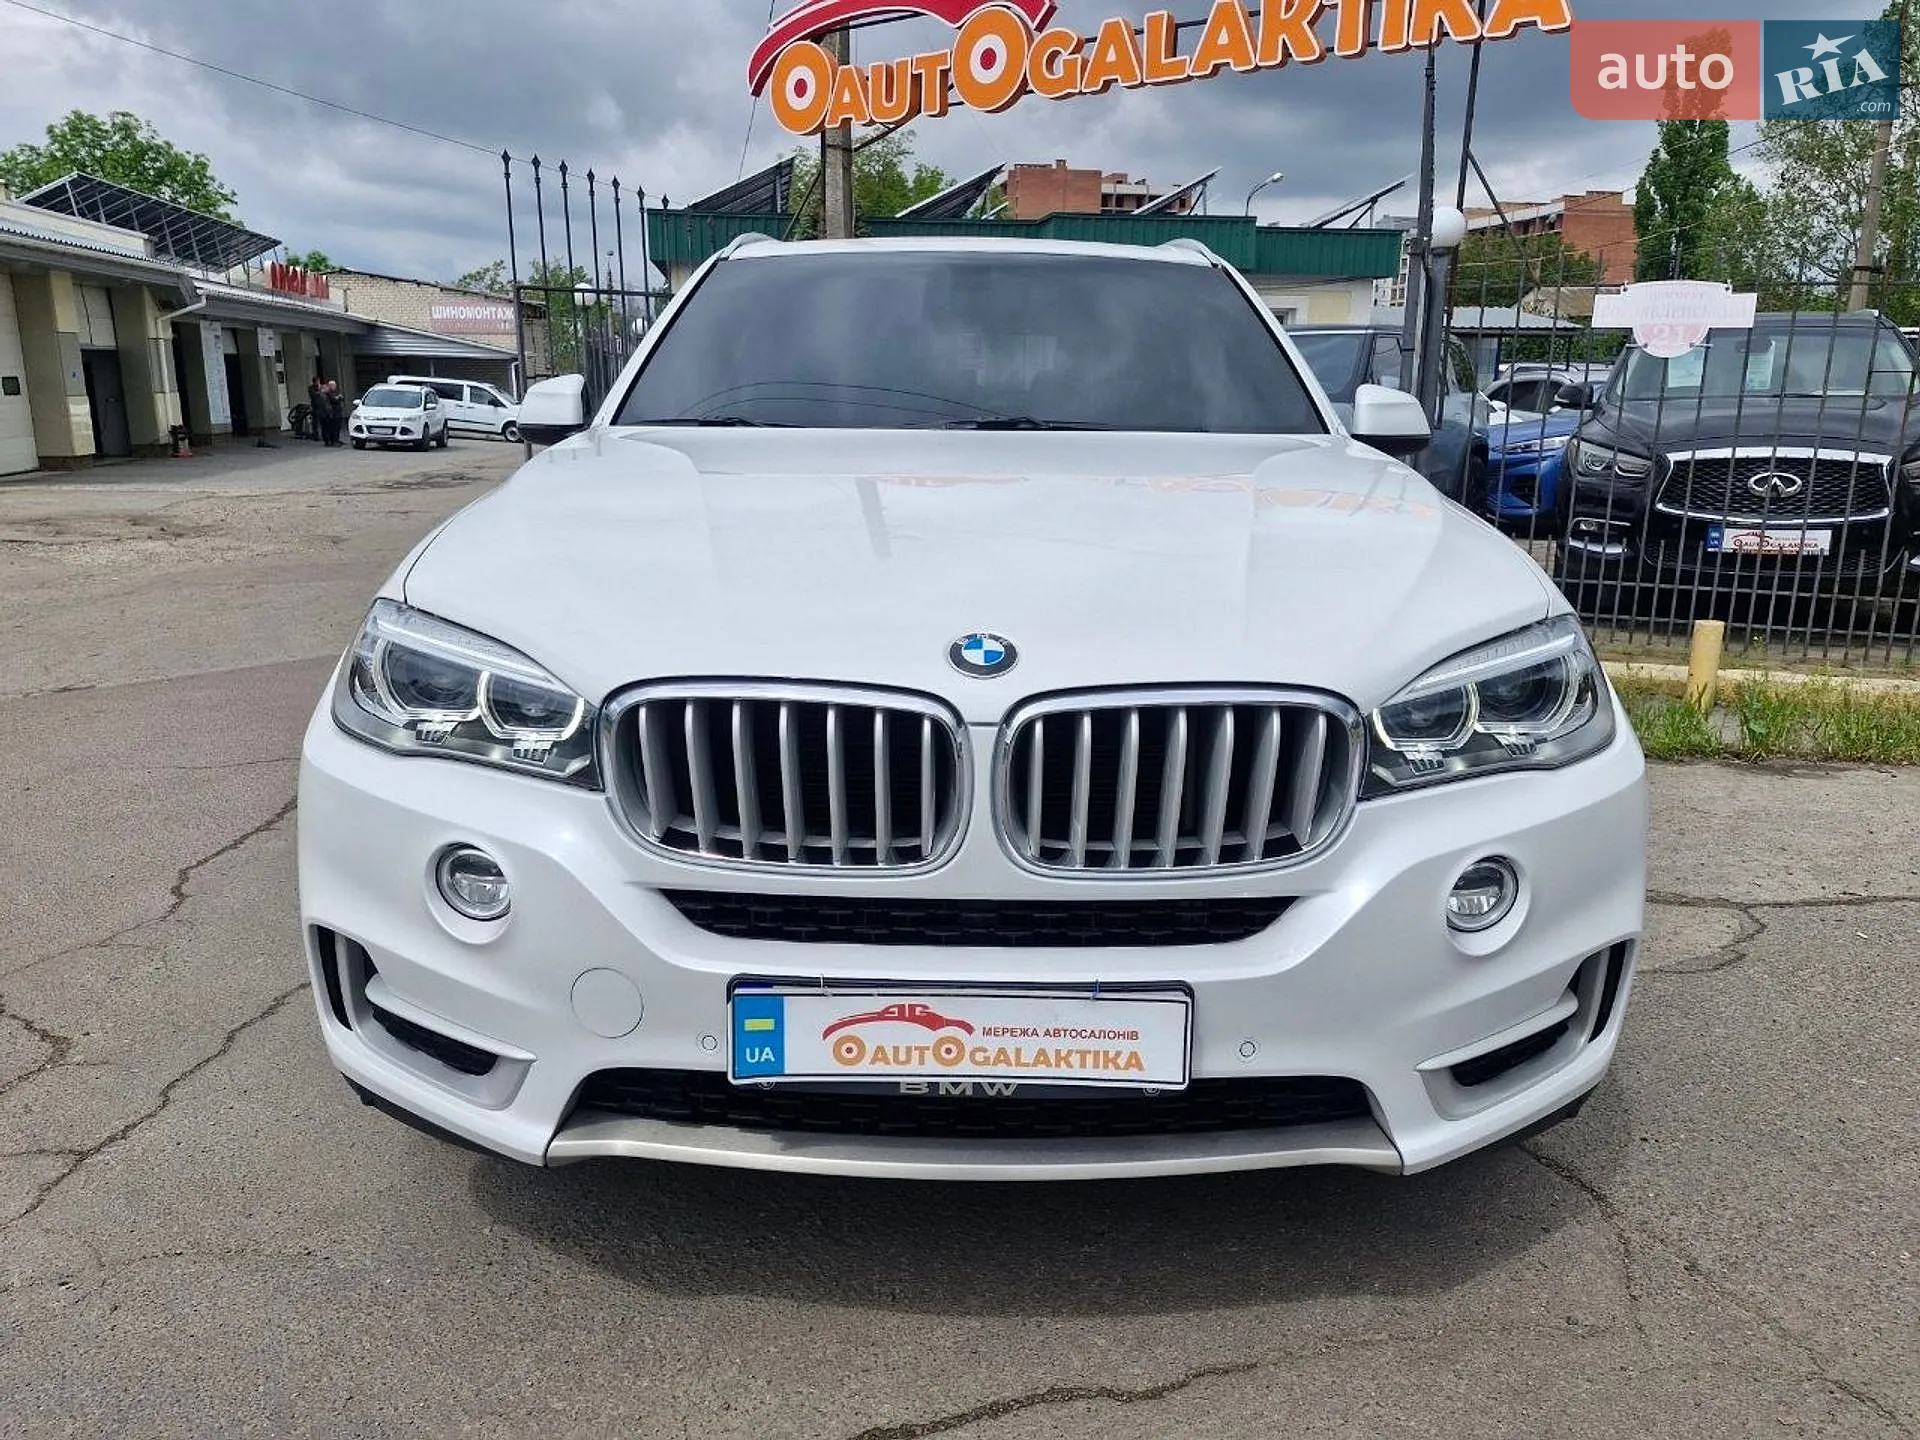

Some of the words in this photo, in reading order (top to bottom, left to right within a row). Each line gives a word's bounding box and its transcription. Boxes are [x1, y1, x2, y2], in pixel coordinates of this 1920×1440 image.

[982, 1026, 1040, 1039] МЕРЕЖА
[1043, 1027, 1140, 1041] АВТОСАЛОНІВ
[745, 1046, 776, 1064] UA
[899, 1081, 1020, 1097] BMW
